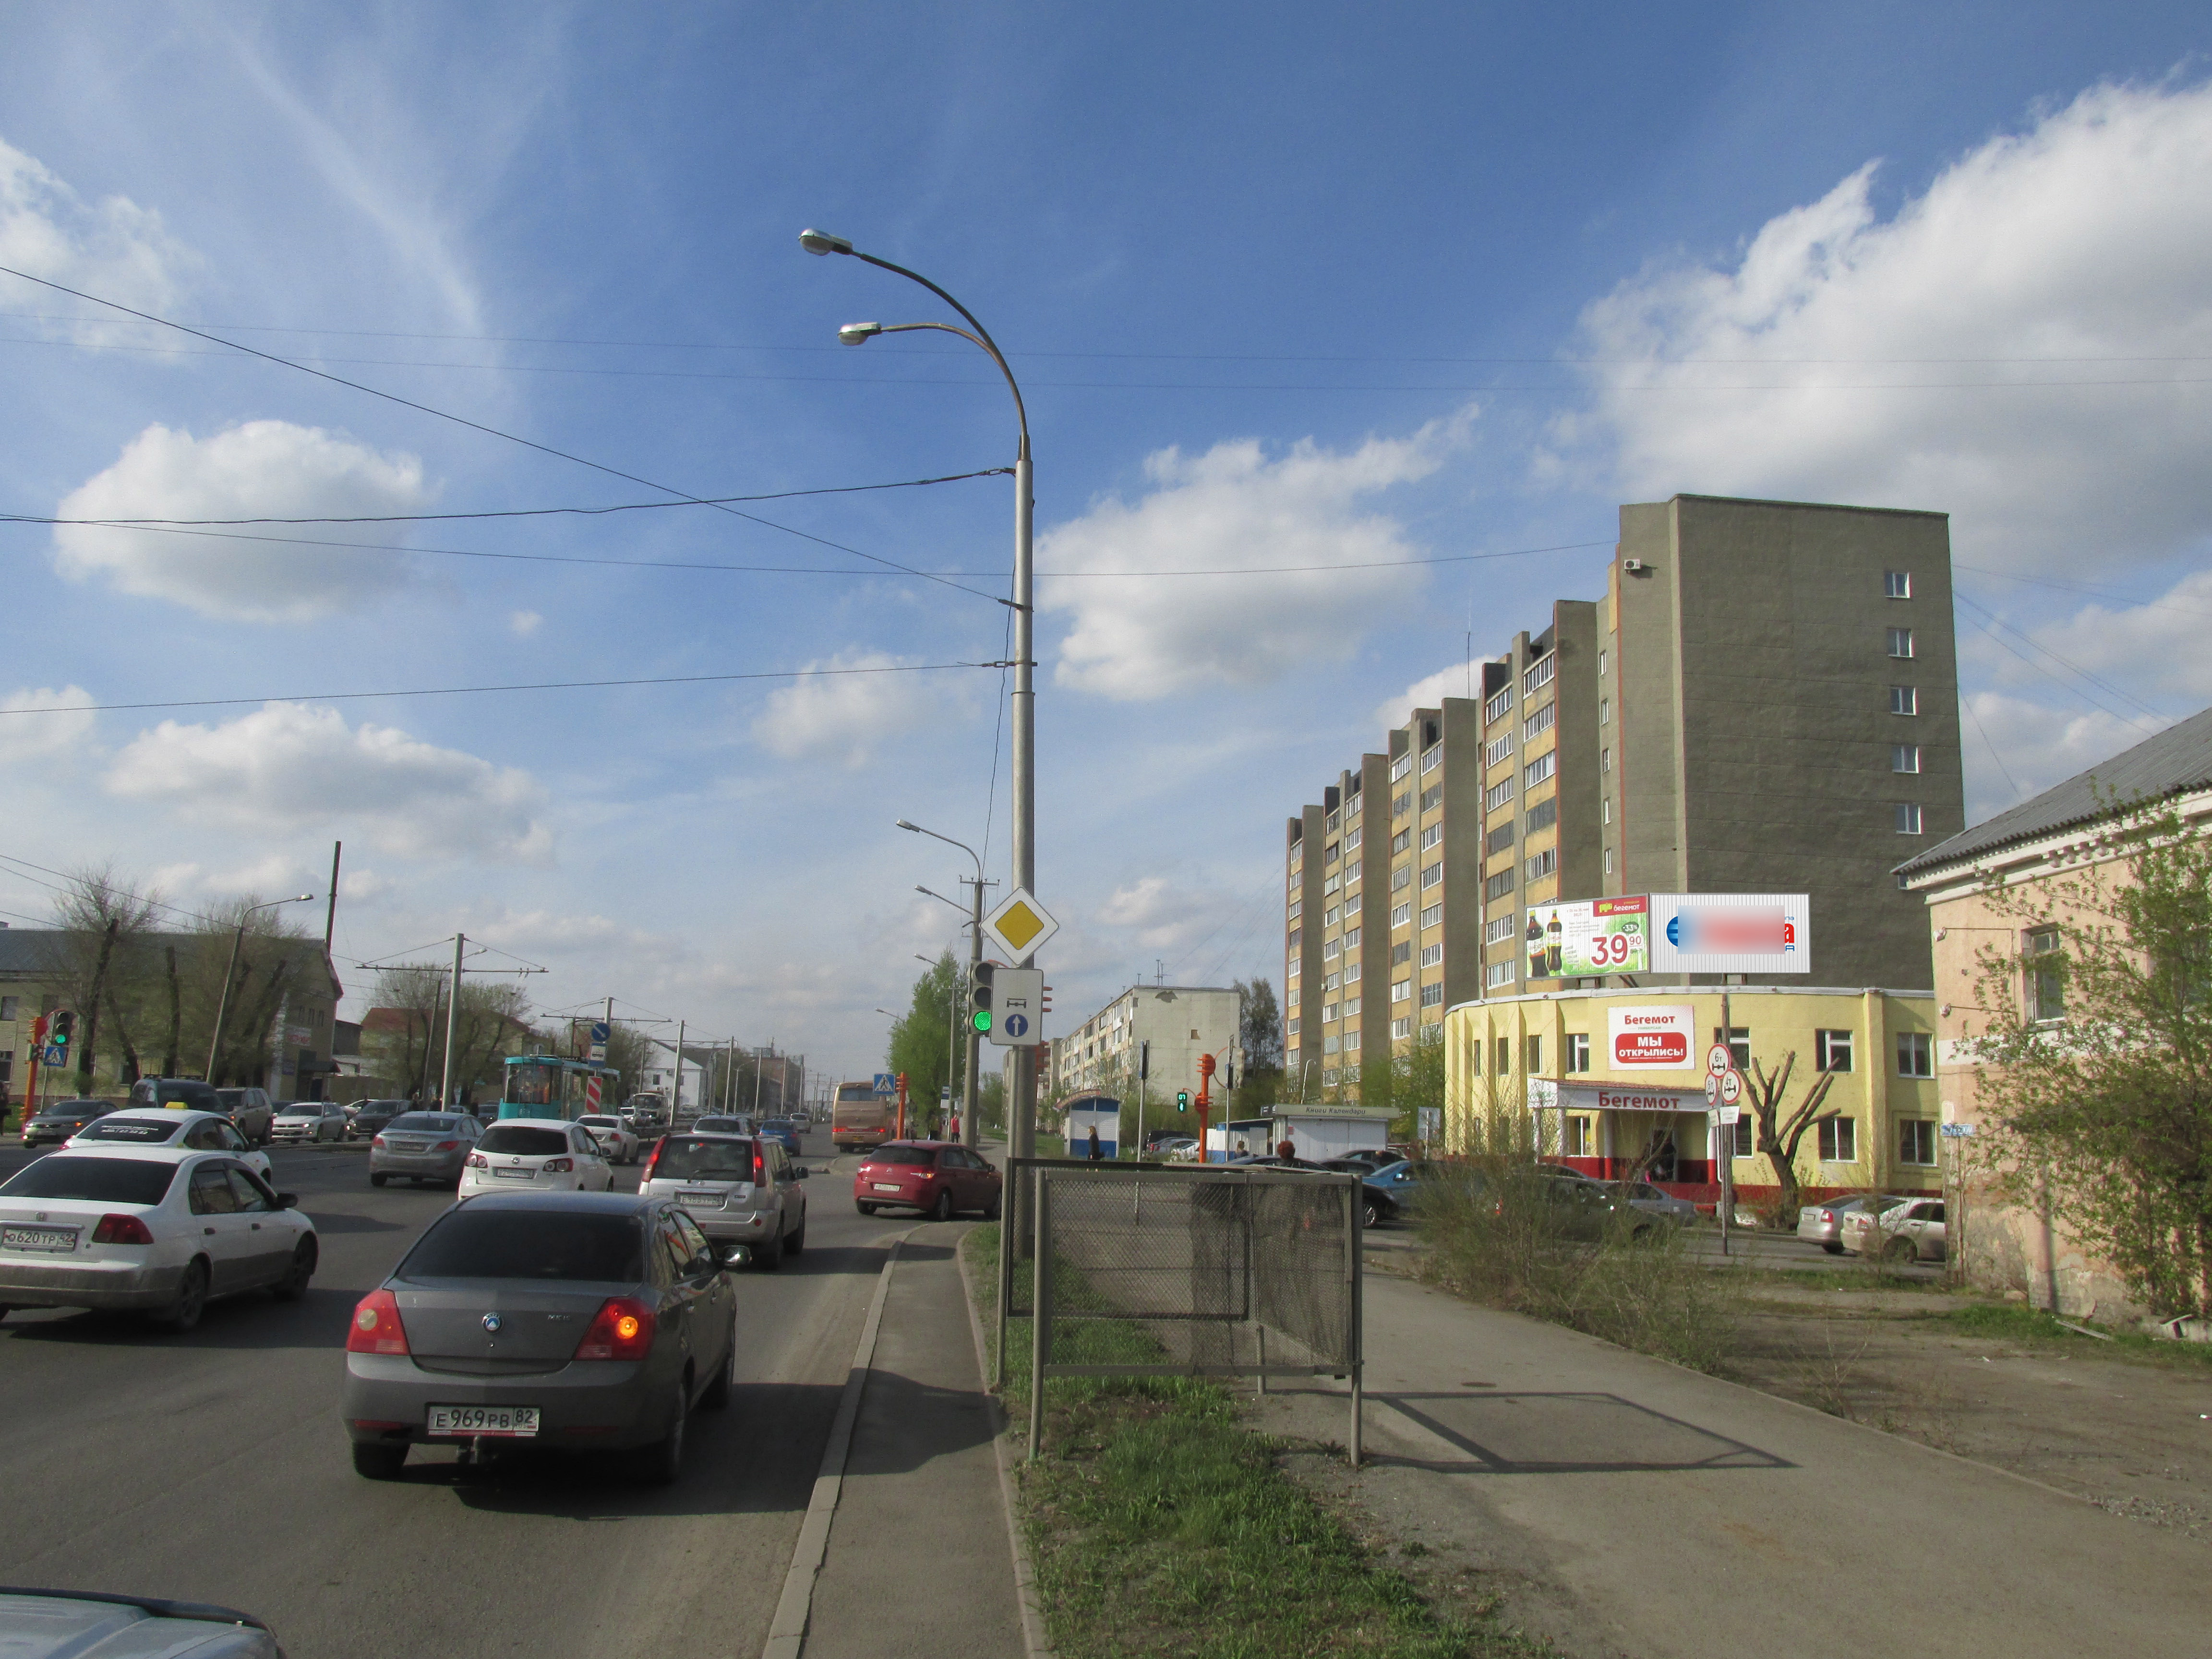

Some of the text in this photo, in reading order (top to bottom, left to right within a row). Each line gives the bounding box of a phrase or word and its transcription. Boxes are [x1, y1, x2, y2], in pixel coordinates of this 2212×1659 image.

[1591, 934, 1628, 965] 39
[1629, 936, 1641, 945] 90
[1624, 1015, 1675, 1024] Бегемот
[1637, 1036, 1662, 1047] МЫ
[1619, 1048, 1683, 1057] ОТКРЫЛИСЬ!
[1599, 1092, 1680, 1109] Бегемот
[516, 1409, 533, 1424] 82
